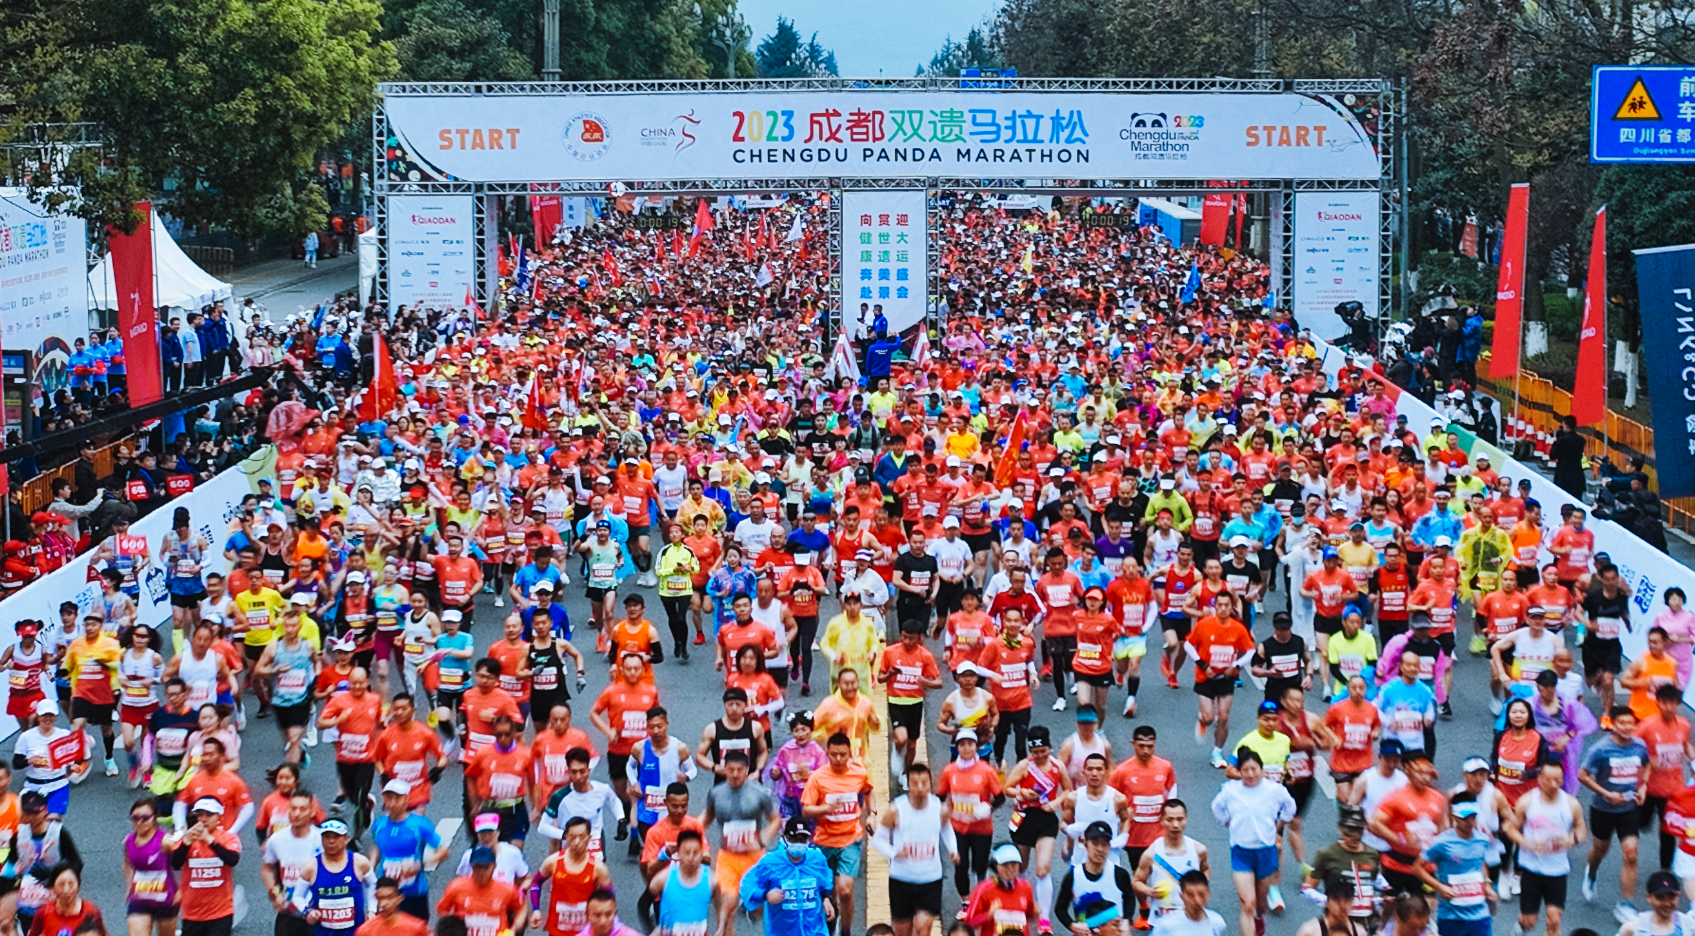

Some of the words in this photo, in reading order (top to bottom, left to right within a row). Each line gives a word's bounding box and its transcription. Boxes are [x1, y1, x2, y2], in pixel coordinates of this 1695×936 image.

[732, 110, 795, 143] 2023
[803, 107, 1090, 145] 成都双遗马拉松
[1173, 115, 1205, 128] 2023
[438, 127, 521, 150] START
[640, 127, 676, 138] CHINA
[1119, 128, 1177, 143] Chengdu
[1245, 125, 1327, 147] START
[1130, 140, 1190, 152] Marathon
[732, 148, 849, 164] CHENGDU
[862, 148, 943, 163] PANDA
[956, 148, 1091, 164] MARATHON
[418, 216, 456, 225] QIAODAN
[1324, 213, 1362, 221] QIAODAN
[860, 213, 873, 299] 向健康奔赴
[170, 479, 191, 488] 600
[121, 539, 146, 550] 600
[322, 907, 353, 920] A1203
